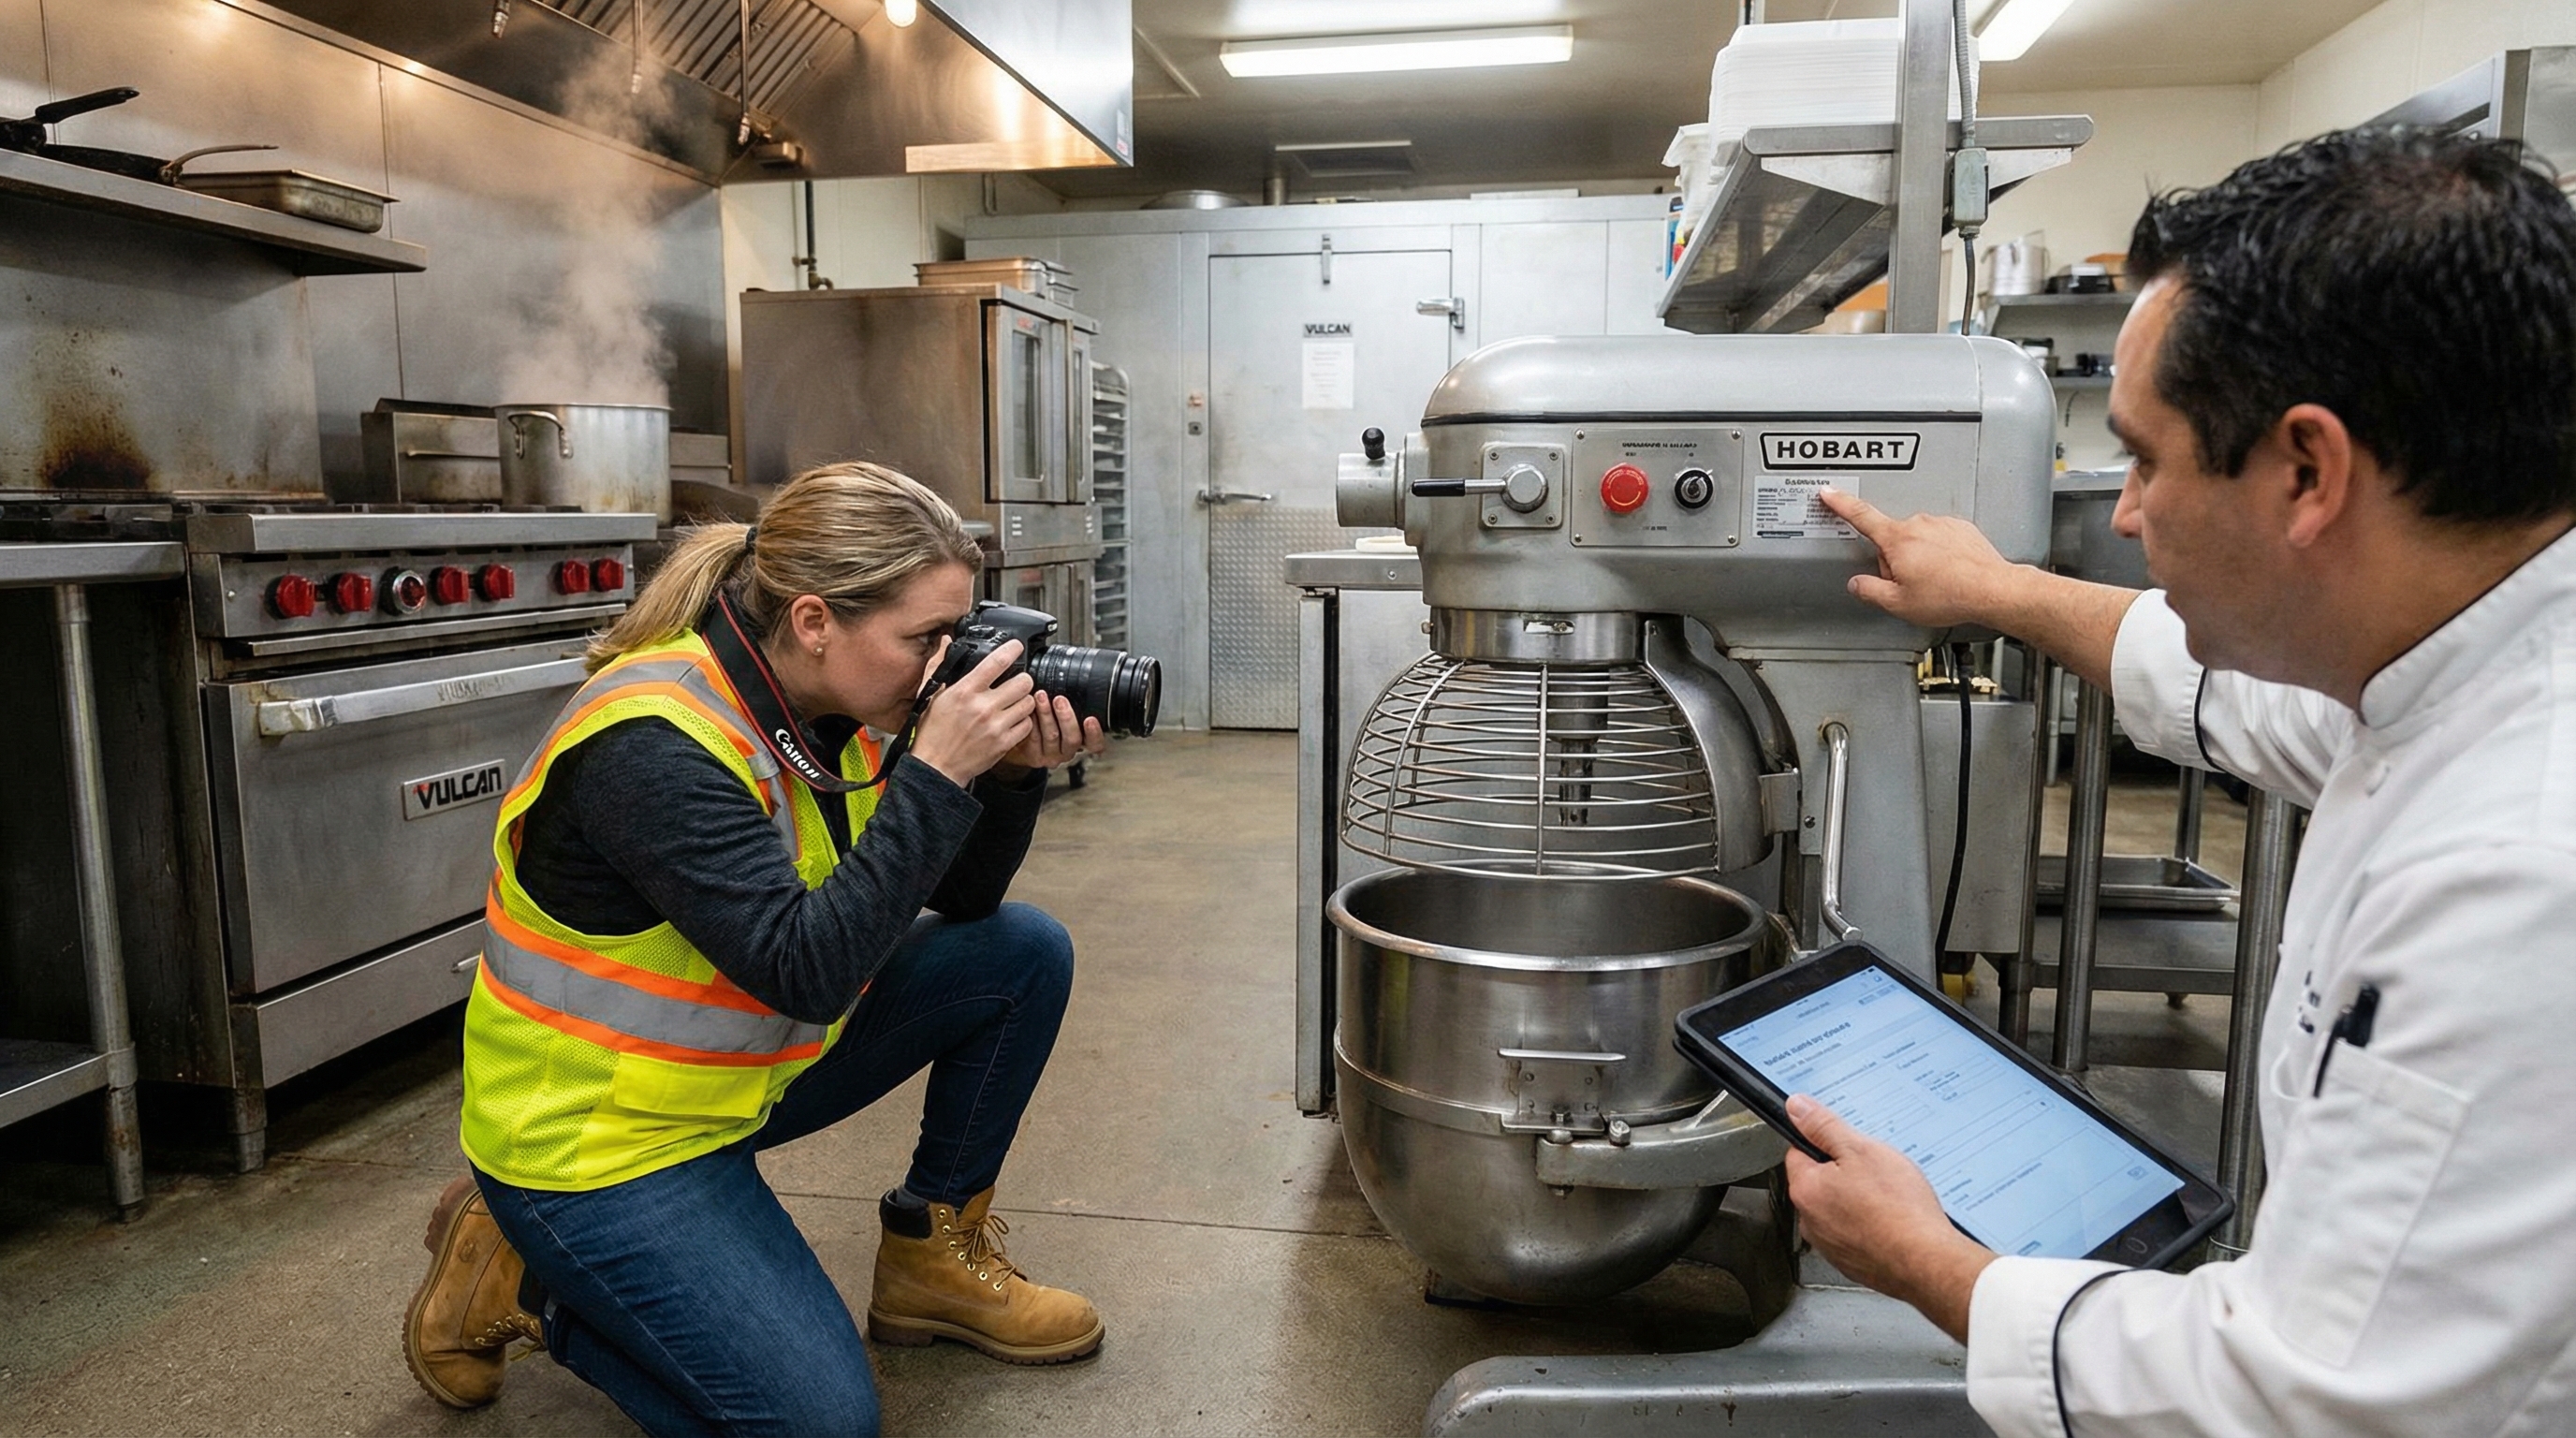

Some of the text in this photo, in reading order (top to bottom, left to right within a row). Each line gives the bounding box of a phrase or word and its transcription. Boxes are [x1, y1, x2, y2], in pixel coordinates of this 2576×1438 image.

[1305, 323, 1351, 334] VULCAN
[1777, 440, 1905, 460] HOBART
[775, 728, 820, 778] Canon
[417, 766, 503, 810] VULCAN
